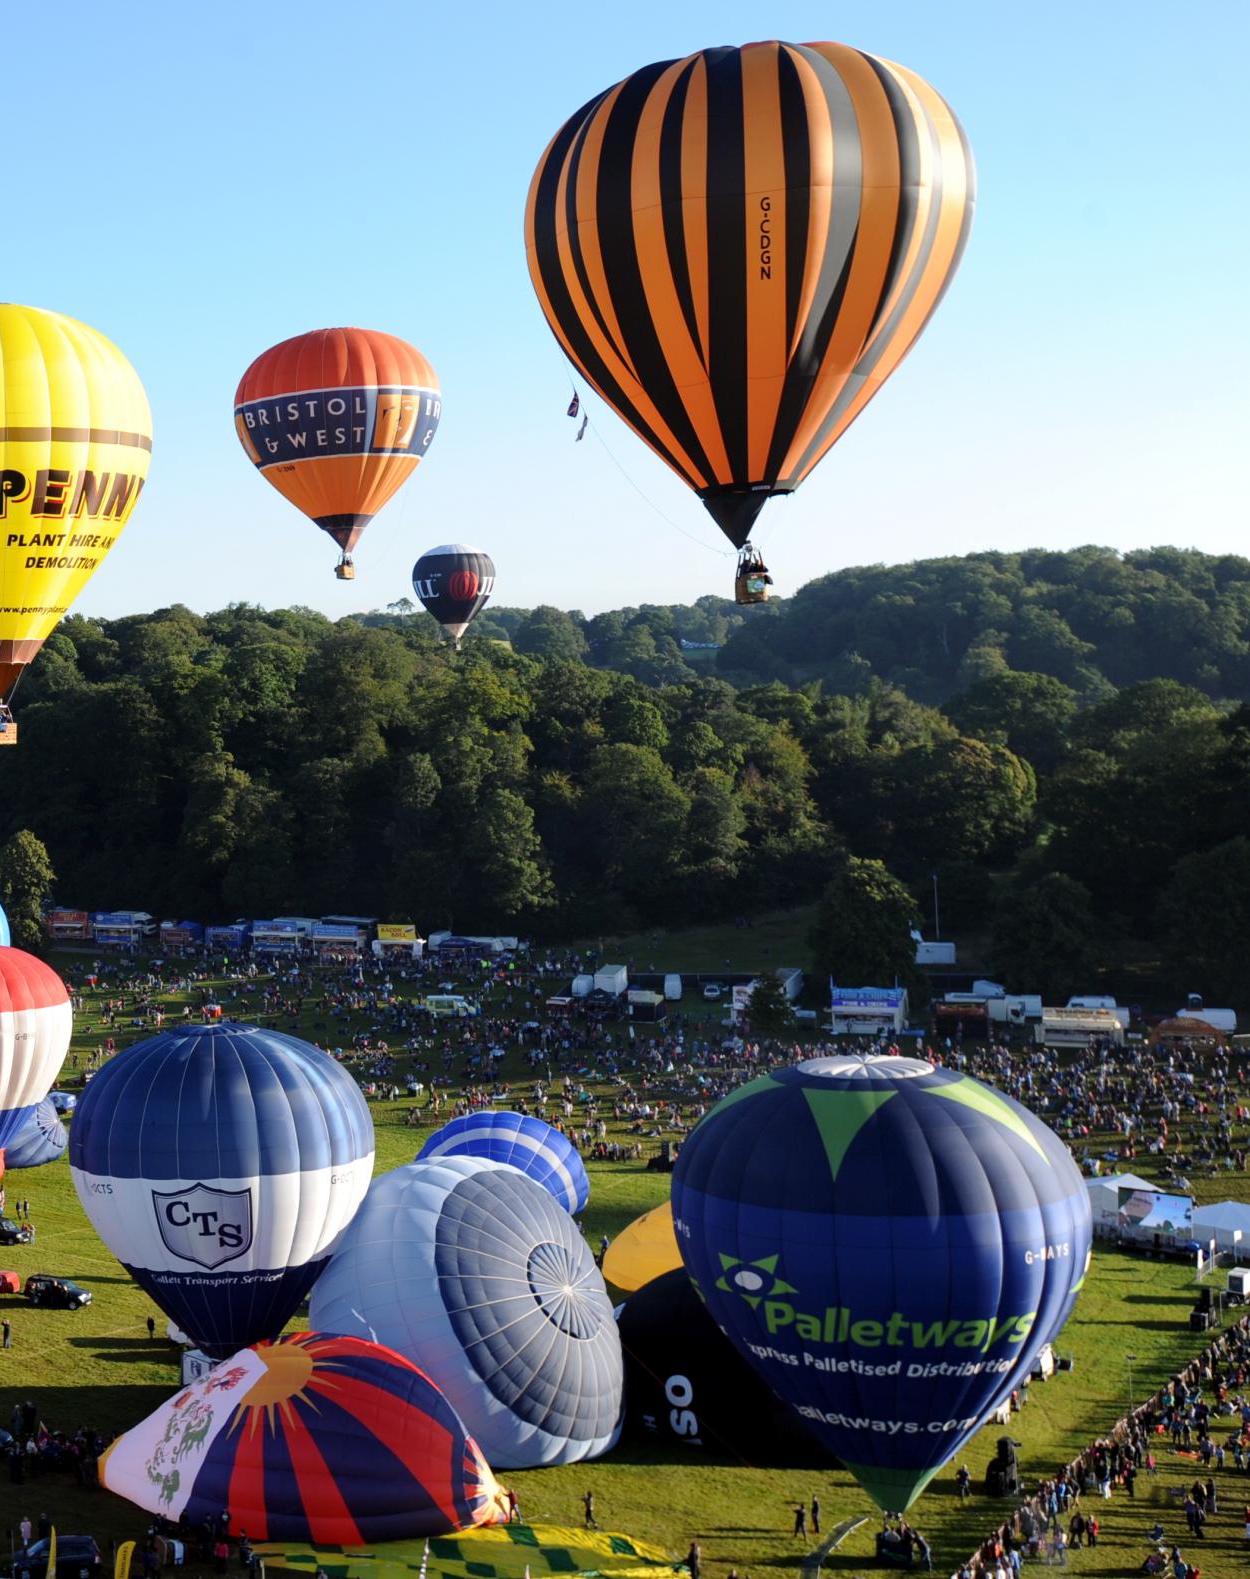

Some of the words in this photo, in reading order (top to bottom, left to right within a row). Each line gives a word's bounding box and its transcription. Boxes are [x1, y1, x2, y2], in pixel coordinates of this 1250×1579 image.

[760, 196, 771, 281] G-CDGN
[245, 397, 366, 429] BRISTOL
[264, 437, 279, 453] &
[287, 426, 365, 450] WEST
[7, 534, 65, 547] PLANT
[69, 533, 101, 548] HIRE
[25, 556, 98, 569] DEMOLITION
[165, 1200, 244, 1249] CTS
[183, 1276, 239, 1288] Transport
[765, 1300, 1038, 1353] Palletways
[803, 1351, 901, 1377] Palletised
